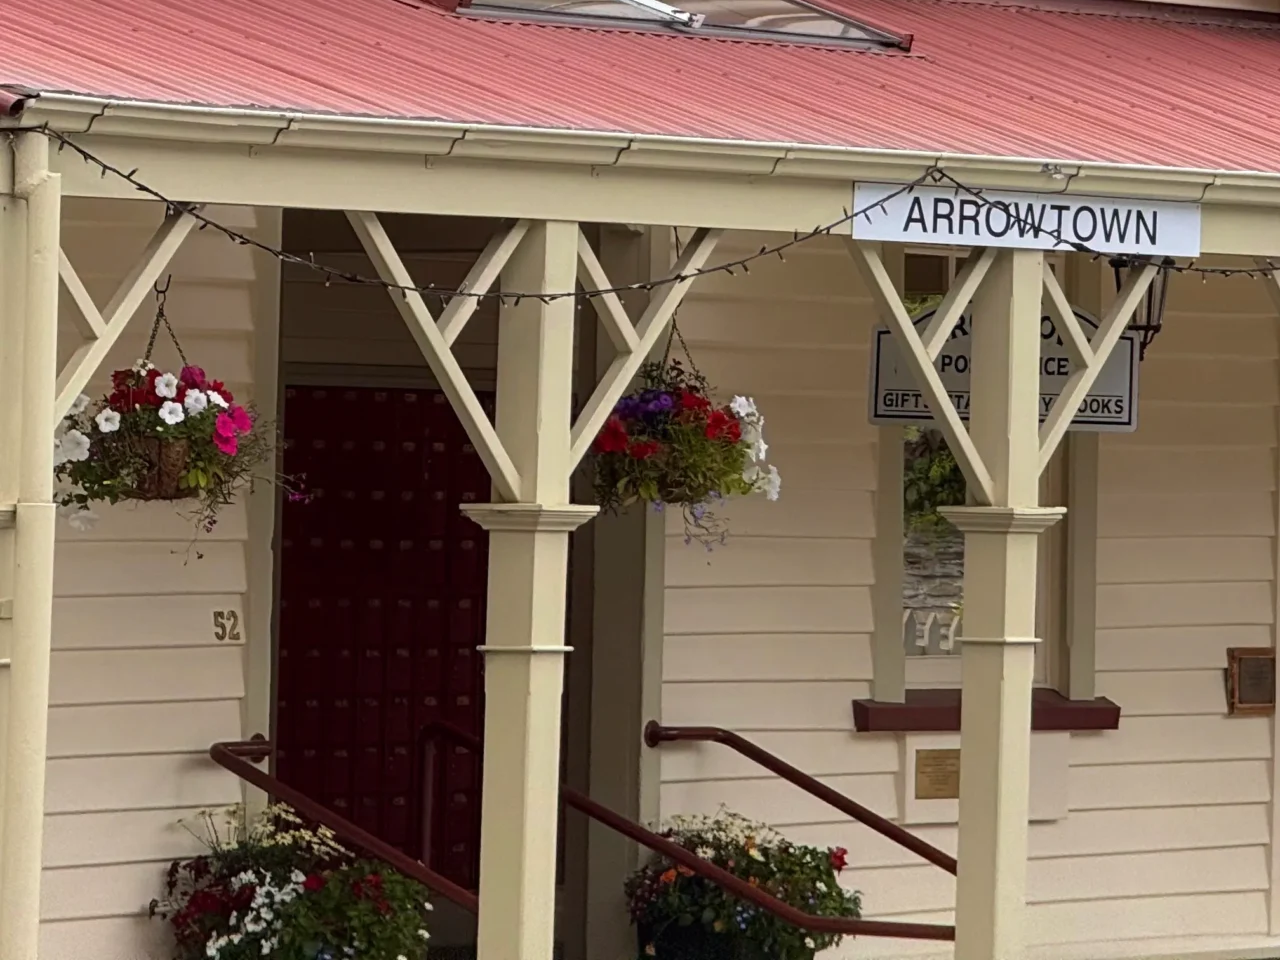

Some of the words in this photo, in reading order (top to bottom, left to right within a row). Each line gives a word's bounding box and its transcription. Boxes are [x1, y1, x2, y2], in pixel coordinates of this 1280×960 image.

[903, 196, 1158, 246] ARROWTOWN
[883, 392, 929, 410] GIFT
[1078, 398, 1124, 415] OOKS
[213, 610, 241, 641] 52
